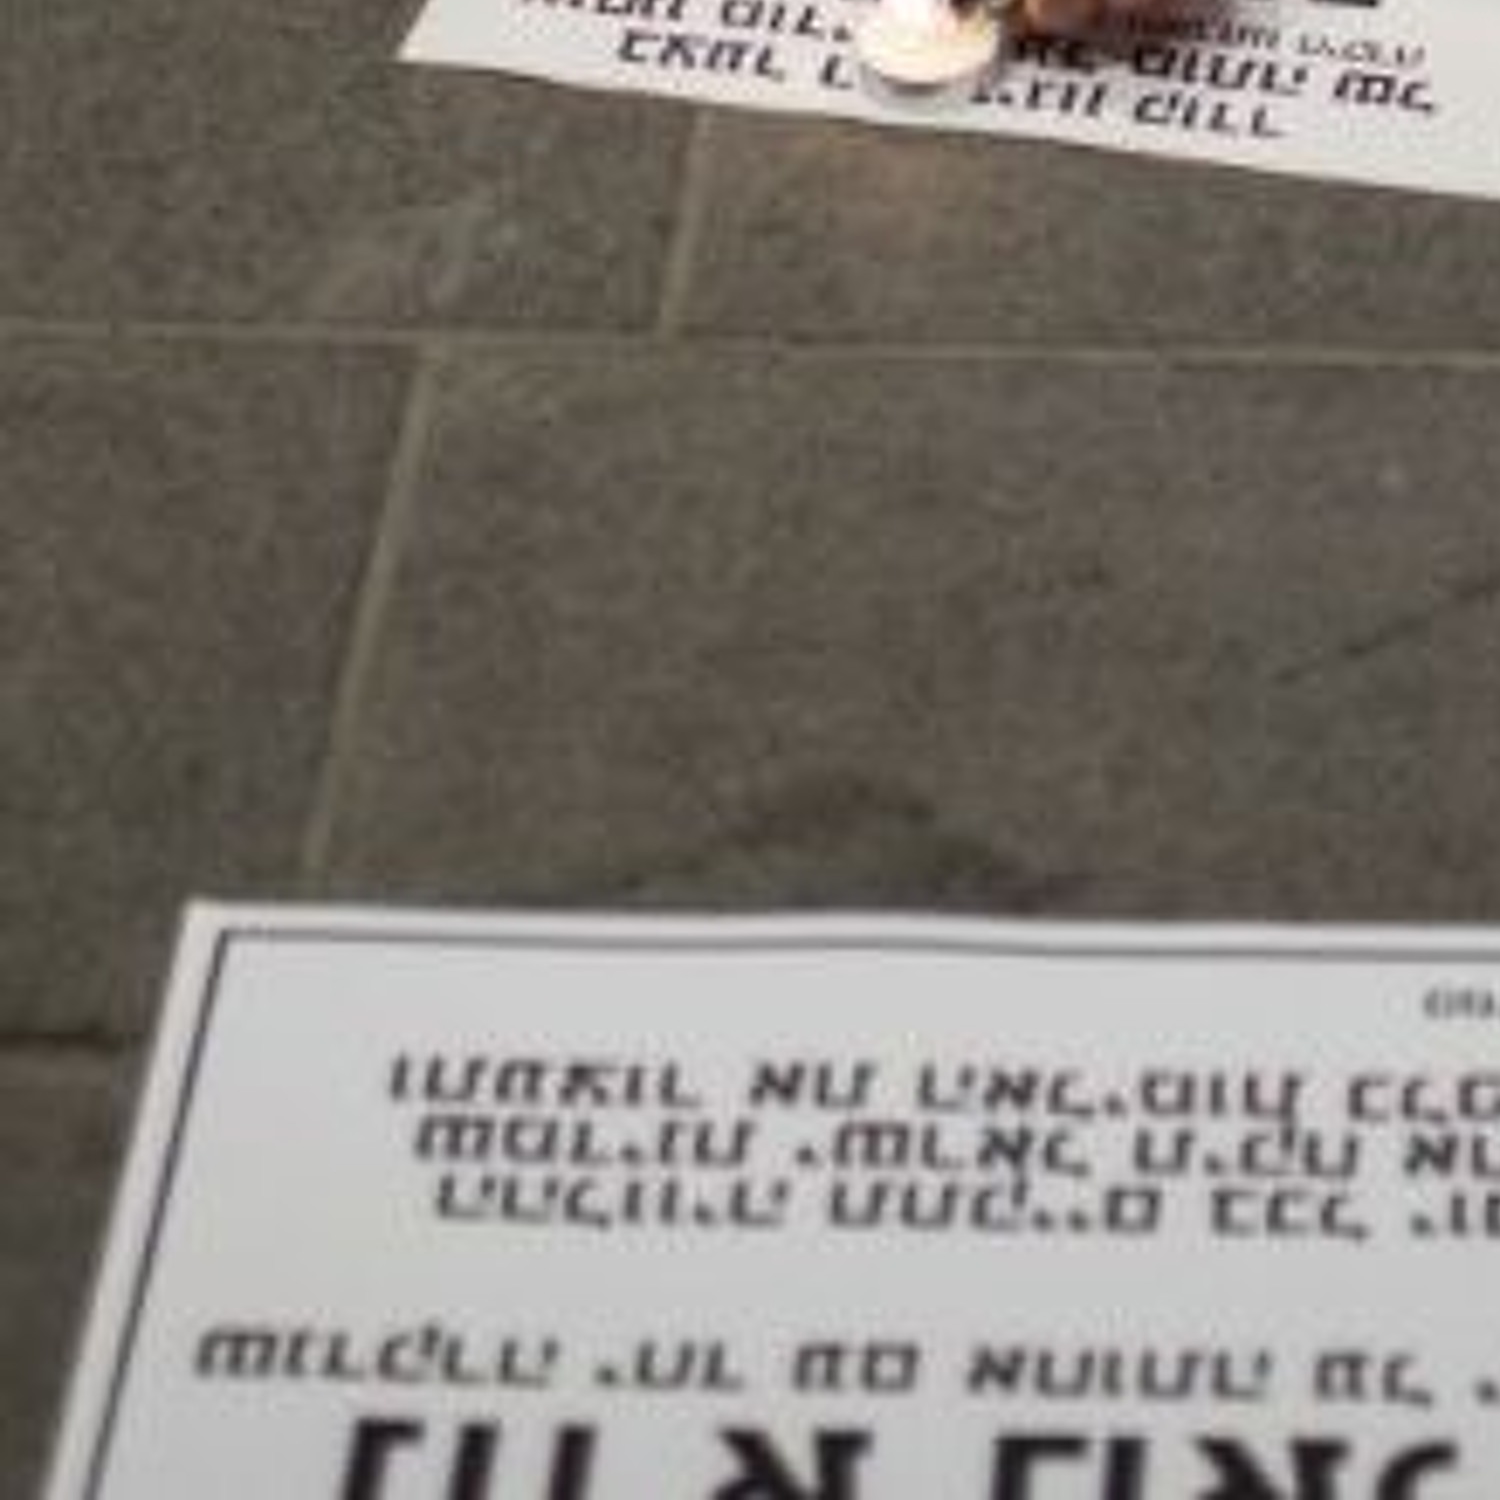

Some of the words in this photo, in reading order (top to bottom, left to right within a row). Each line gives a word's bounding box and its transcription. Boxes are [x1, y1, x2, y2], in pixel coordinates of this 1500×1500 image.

[617, 29, 784, 83] בצער
[1131, 95, 1285, 140] קודר
[1131, 43, 1308, 97] מותה
[1332, 72, 1434, 115] של
[387, 1054, 703, 1109] ותעצור
[747, 1059, 878, 1112] את
[915, 1064, 1306, 1126] האלימות
[412, 1114, 755, 1172] שמדינת
[793, 1120, 1090, 1178] ישראל
[1131, 1122, 1363, 1180] תיקח
[431, 1172, 791, 1232] ההלוויה
[826, 1177, 1163, 1239] תתקיים
[1210, 1187, 1372, 1246] בכל
[192, 1323, 561, 1392] שנדקרה
[592, 1339, 744, 1396] יחד
[790, 1341, 922, 1399] עם
[965, 1344, 1274, 1404] אחותה
[1310, 1350, 1435, 1410] על
